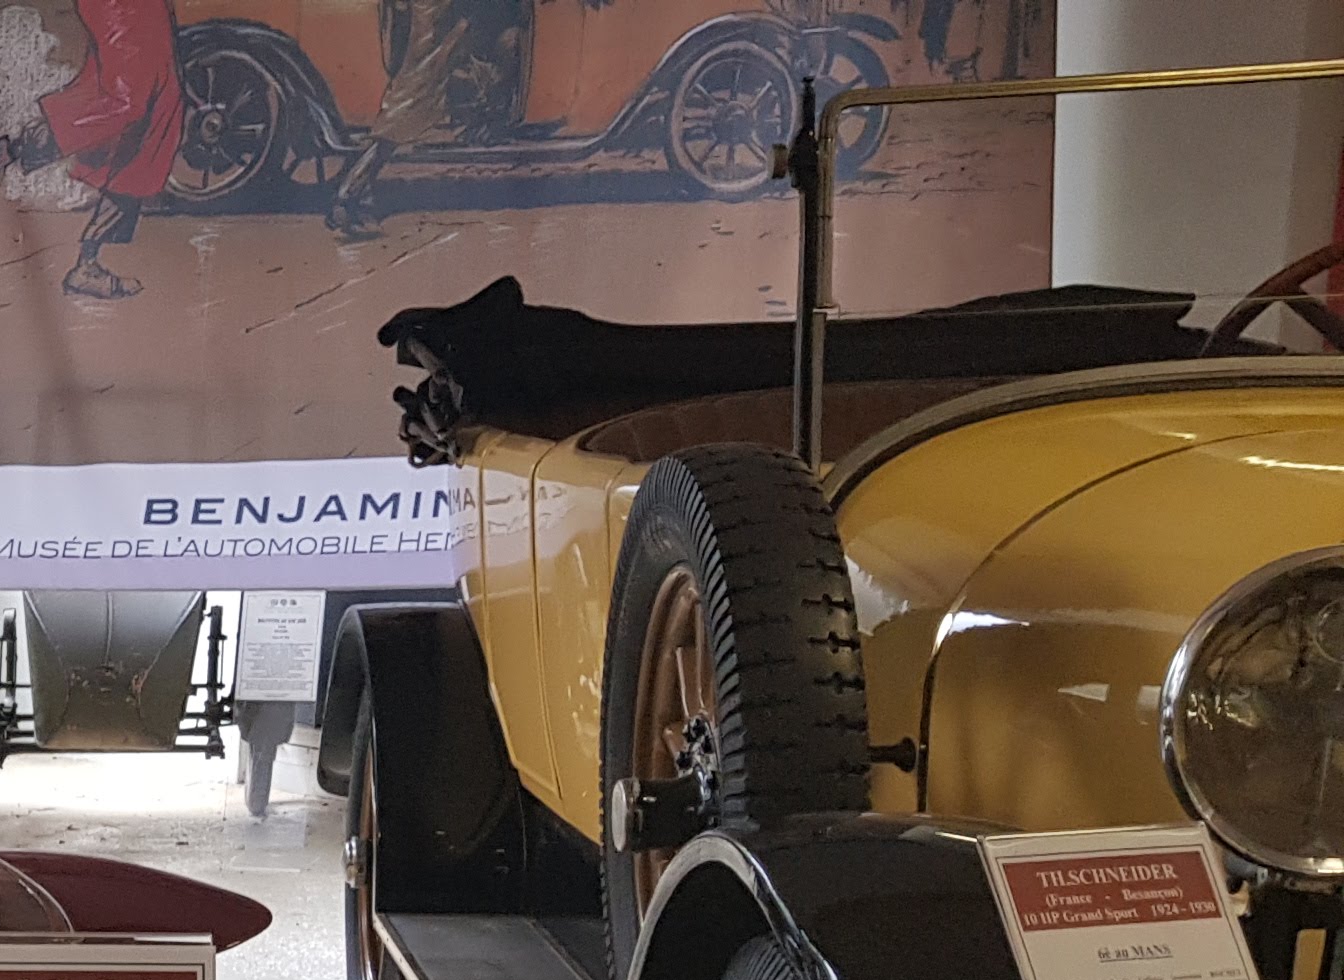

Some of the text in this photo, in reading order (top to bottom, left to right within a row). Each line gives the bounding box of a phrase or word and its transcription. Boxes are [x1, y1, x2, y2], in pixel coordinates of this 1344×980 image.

[111, 539, 154, 558] DE
[163, 534, 388, 558] L'AUTOMOBILE
[1036, 863, 1179, 888] TH.SCHNEIDER
[1045, 893, 1092, 908] (France
[1122, 887, 1183, 902] Besançon)
[1024, 913, 1038, 926] 10
[1040, 911, 1060, 925] HP
[1063, 908, 1103, 923] Grand
[1106, 906, 1139, 921] Sport
[1150, 903, 1178, 917] 1924
[1189, 901, 1217, 914] 1930
[1131, 945, 1172, 957] MANS
